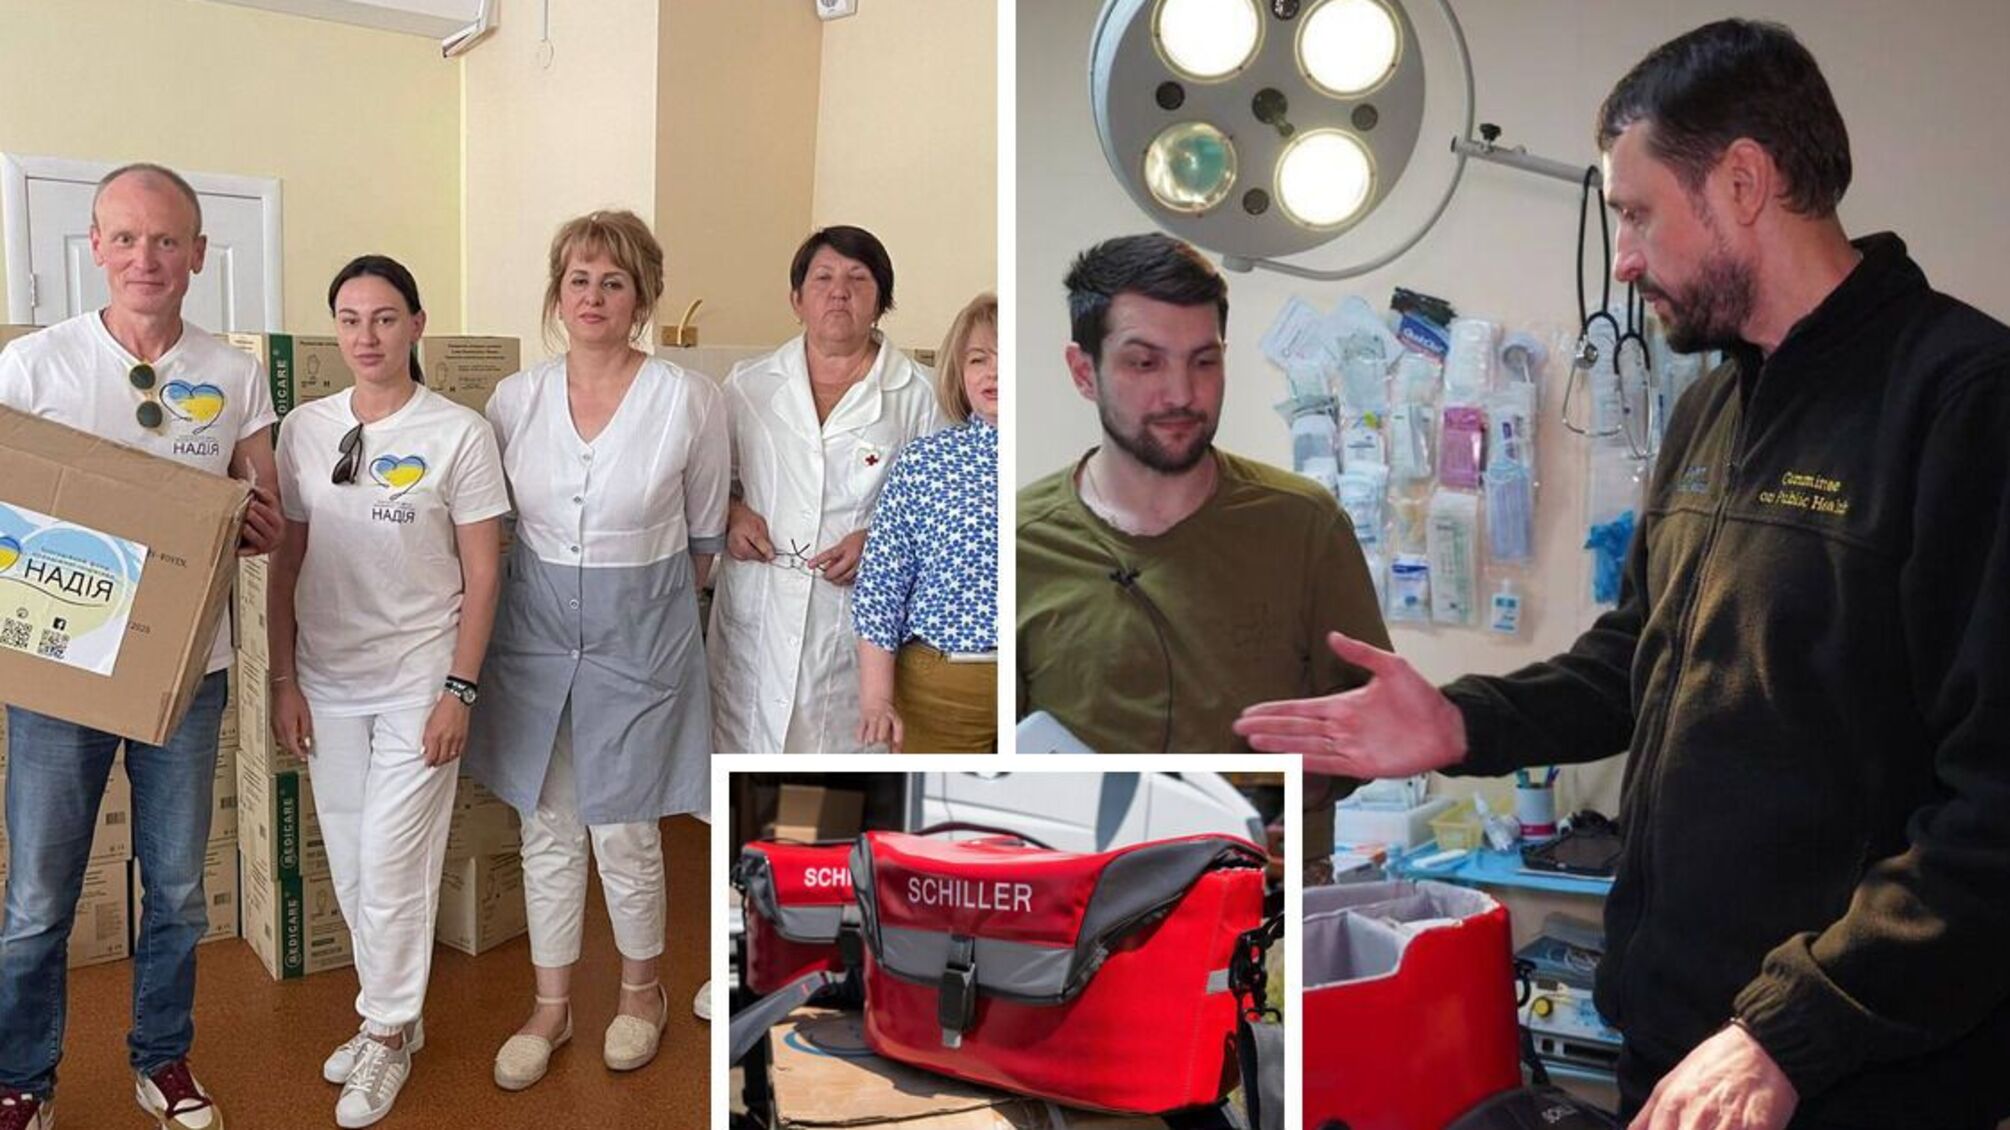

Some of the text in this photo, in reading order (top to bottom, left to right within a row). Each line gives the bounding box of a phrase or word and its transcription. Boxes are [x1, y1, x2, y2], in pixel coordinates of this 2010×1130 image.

[277, 360, 288, 418] DICARE
[173, 441, 220, 457] НАДІЯ
[371, 507, 416, 524] НАДІЯ
[24, 557, 114, 602] НАДІЯ
[907, 876, 1033, 912] SCHILLER
